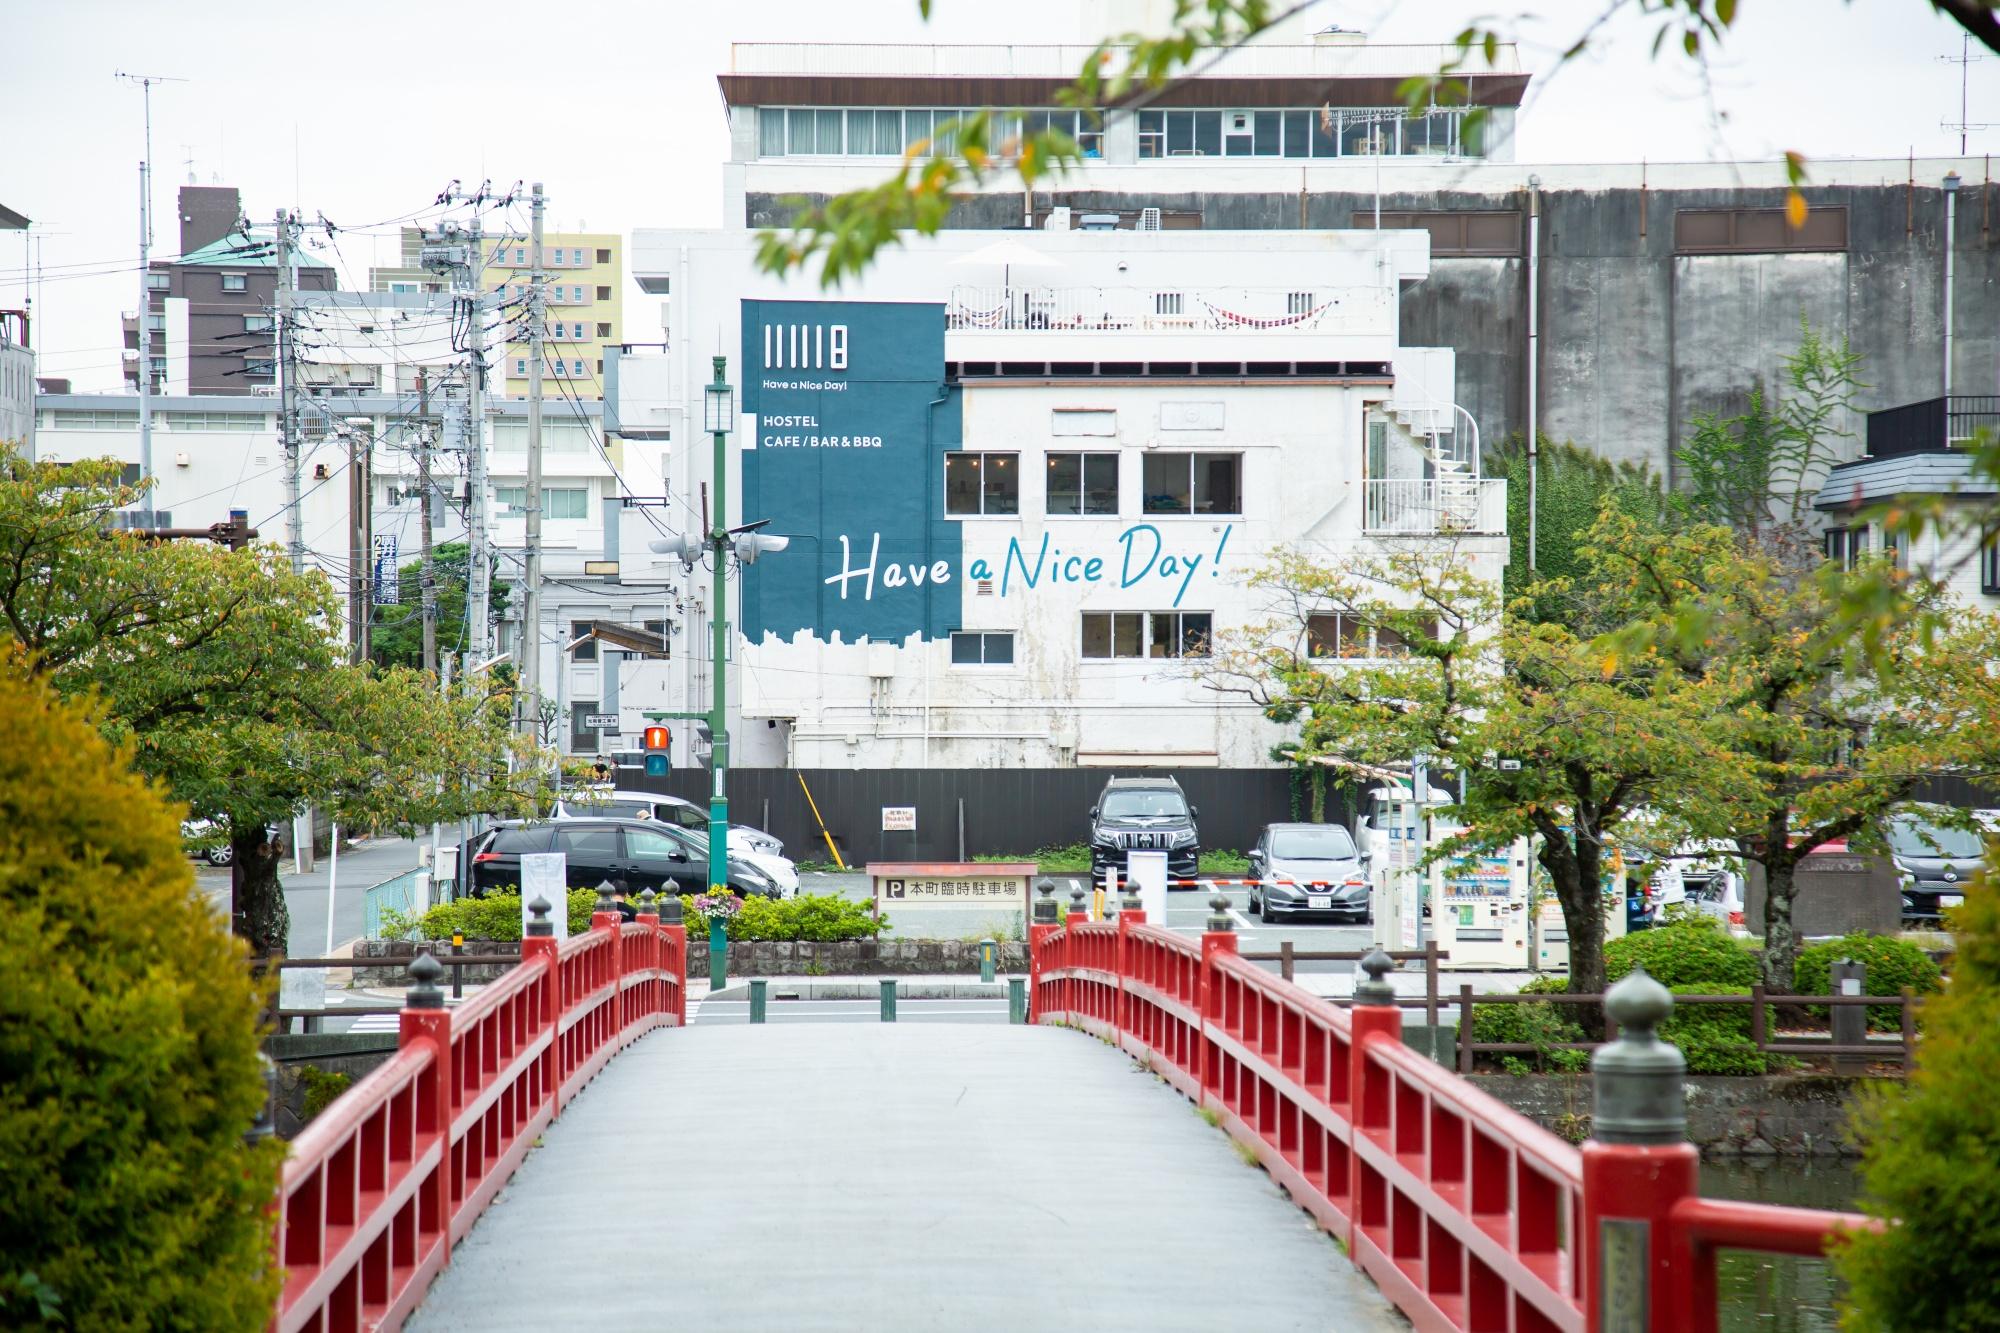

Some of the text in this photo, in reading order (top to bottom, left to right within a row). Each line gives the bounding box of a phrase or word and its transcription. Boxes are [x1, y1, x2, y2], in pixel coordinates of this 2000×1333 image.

[762, 379, 848, 392] Have a Nice Day!
[763, 414, 819, 427] HOSTEL
[764, 435, 800, 447] CAFE
[810, 436, 839, 448] BAR
[853, 436, 882, 448] BBQ
[824, 523, 1233, 609] Have a Nice Day!
[909, 880, 1017, 897] 本町臨時駐車場
